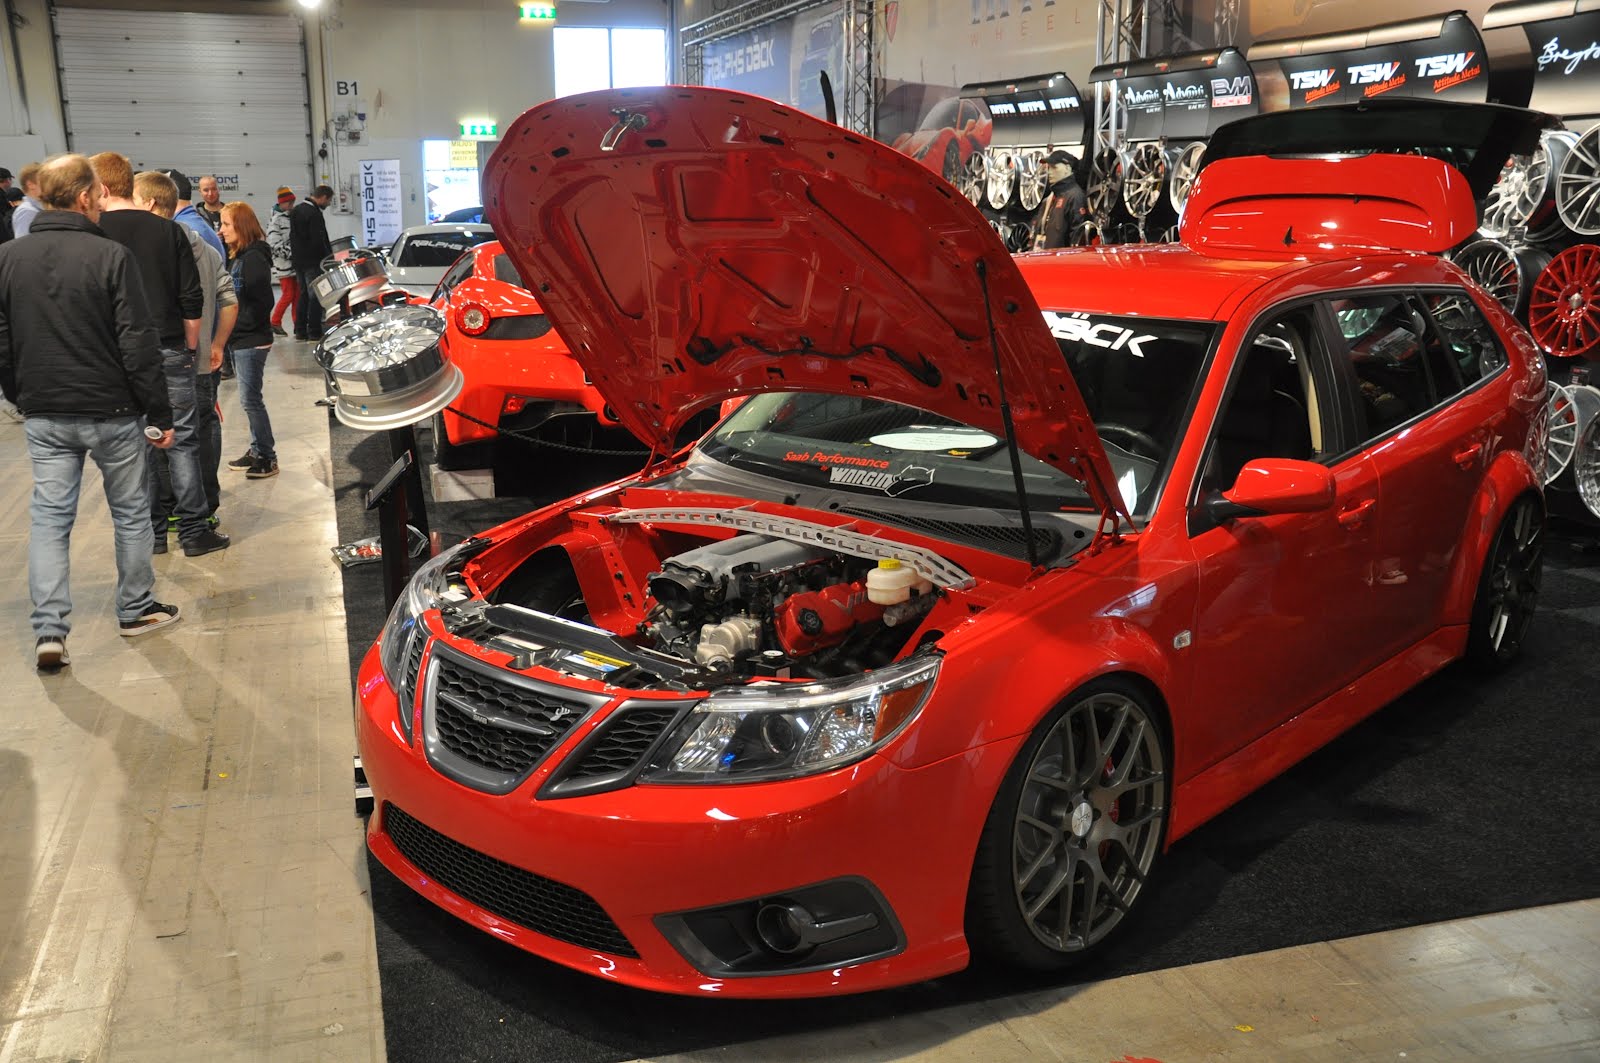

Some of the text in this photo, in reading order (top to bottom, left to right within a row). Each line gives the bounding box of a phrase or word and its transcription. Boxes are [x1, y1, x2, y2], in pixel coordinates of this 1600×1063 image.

[1347, 61, 1400, 84] TSW
[1415, 51, 1475, 77] TSW
[1290, 68, 1336, 89] TSW
[336, 81, 358, 96] B1
[410, 240, 463, 251] RALPHS
[783, 451, 890, 469] Saab Performance
